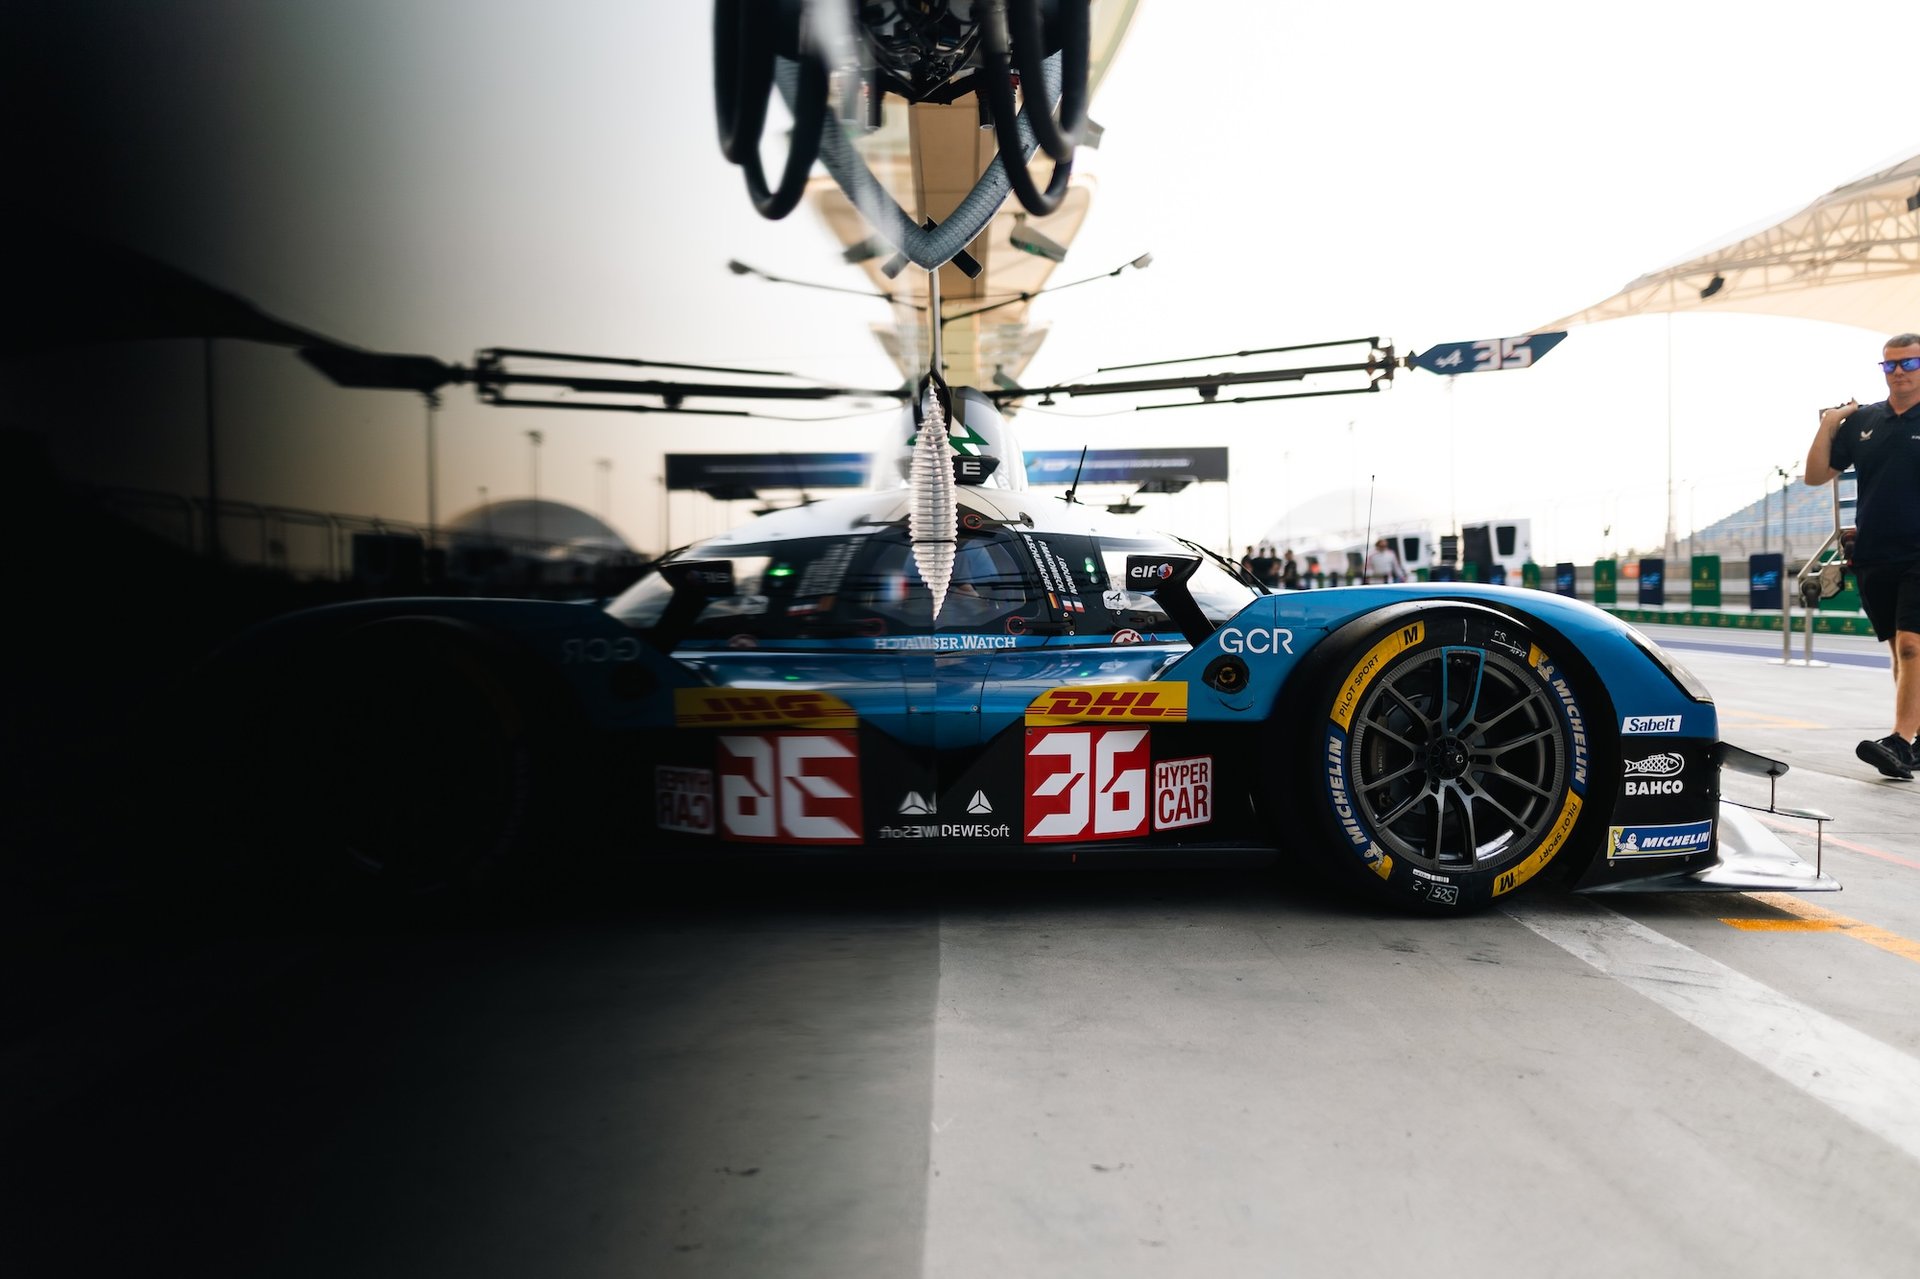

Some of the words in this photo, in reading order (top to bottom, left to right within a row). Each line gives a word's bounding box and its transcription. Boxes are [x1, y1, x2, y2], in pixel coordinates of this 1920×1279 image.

[1472, 336, 1532, 372] 35
[1131, 565, 1157, 578] elf
[1219, 627, 1294, 655] GCR
[1403, 626, 1418, 645] M
[1339, 685, 1356, 717] PILOT
[1354, 654, 1380, 686] SPORT
[1048, 691, 1166, 717] DHL
[1552, 679, 1587, 785] MICHELIN
[1629, 718, 1675, 732] Sabelt
[1027, 729, 1150, 837] 36
[1158, 762, 1209, 789] HYPER
[1625, 780, 1684, 796] BAHCO
[1158, 784, 1209, 824] CAR
[1328, 736, 1367, 845] MICHELIN
[941, 824, 1010, 838] DEWESoft
[1561, 802, 1578, 833] PILOT
[1539, 832, 1562, 863] SPORT
[1641, 831, 1710, 848] MICHELIN
[1499, 872, 1514, 891] M
